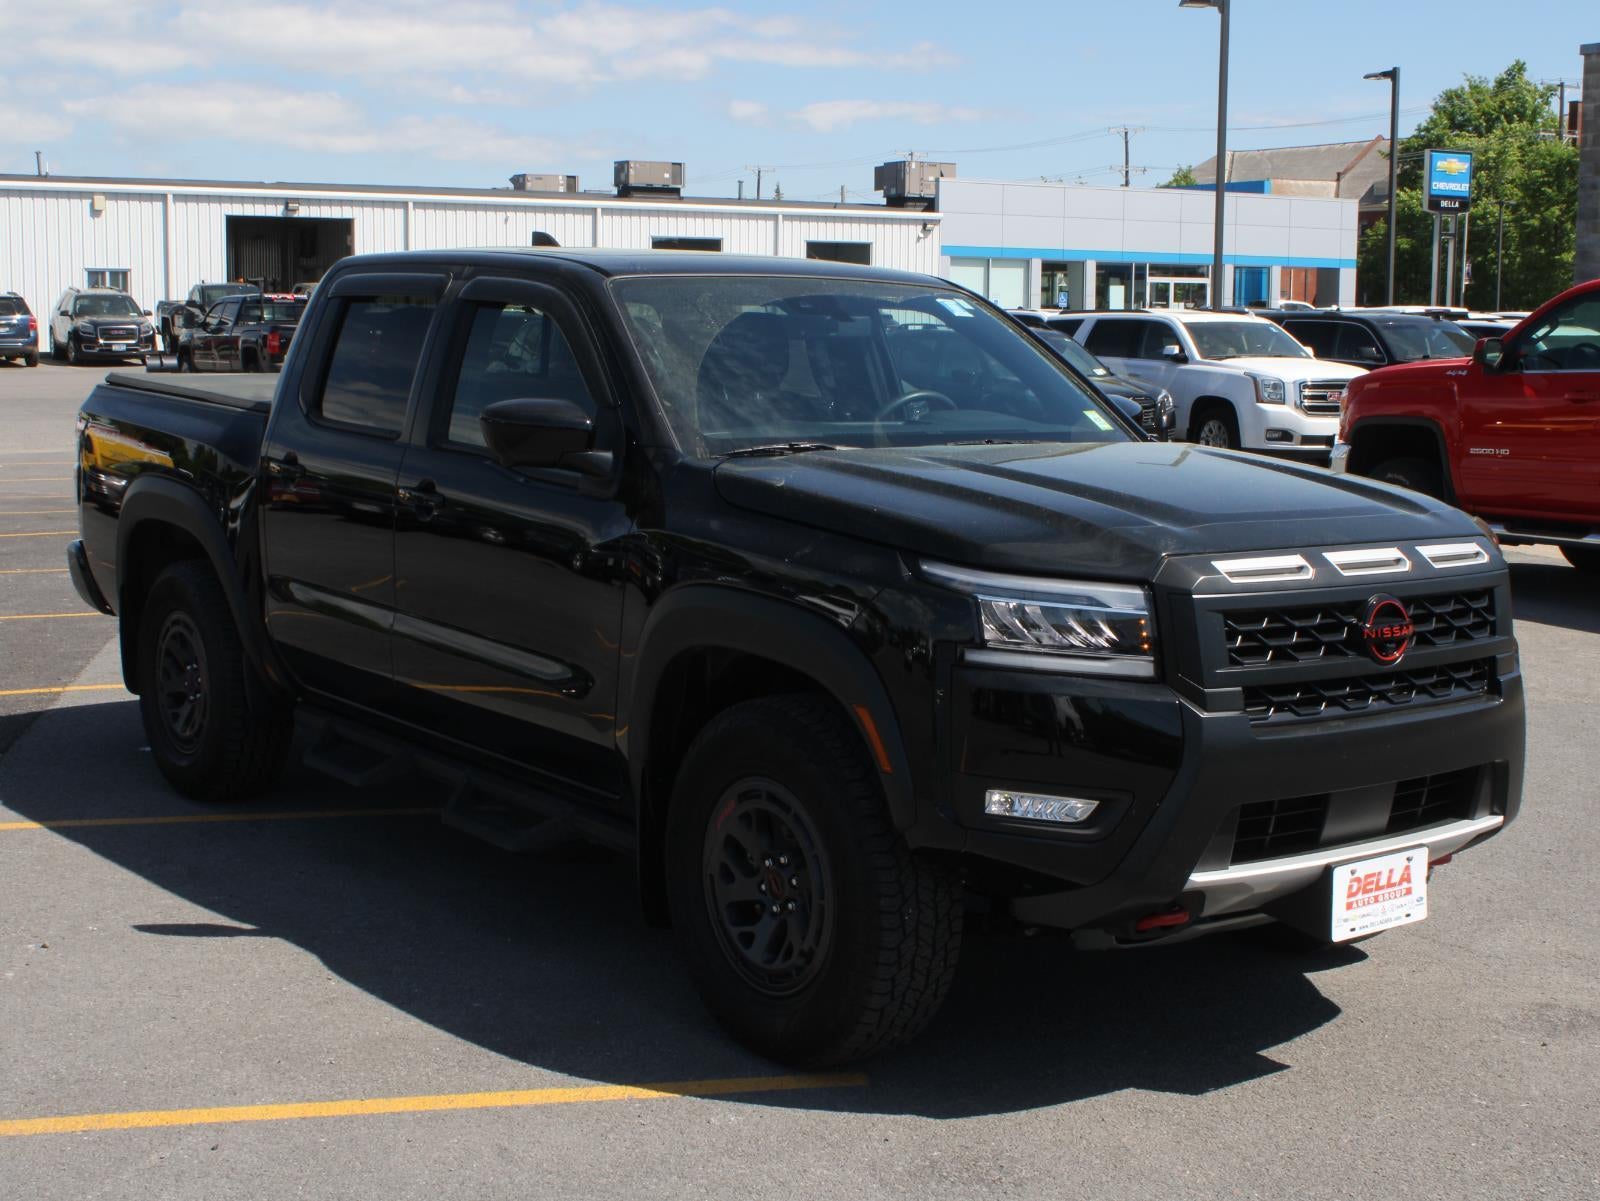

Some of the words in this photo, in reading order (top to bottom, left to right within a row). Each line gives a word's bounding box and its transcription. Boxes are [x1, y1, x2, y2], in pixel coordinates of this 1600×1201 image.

[1432, 181, 1469, 191] CHEVROLET
[1440, 200, 1459, 208] DELLA
[1346, 864, 1412, 899] DELLA
[1352, 896, 1375, 909] AUTO
[1377, 889, 1406, 902] GROUP
